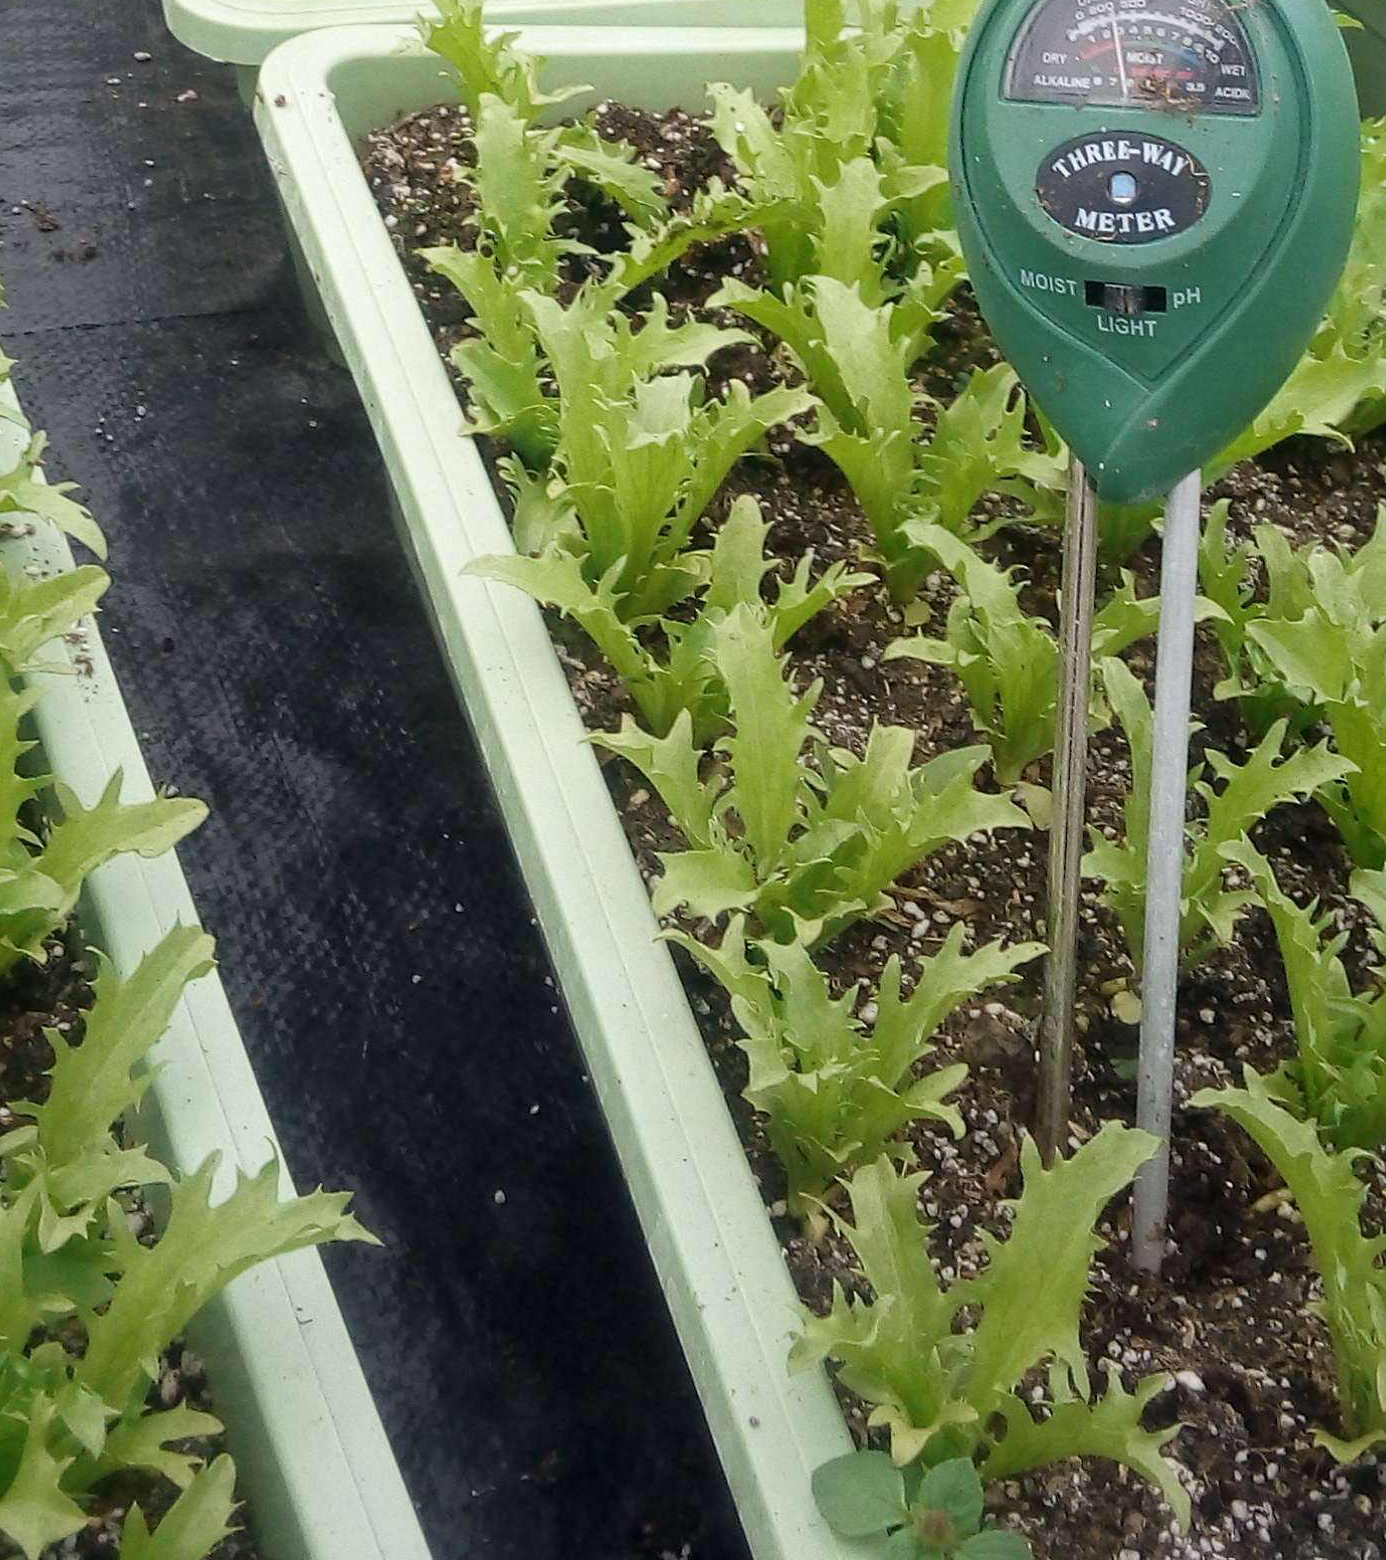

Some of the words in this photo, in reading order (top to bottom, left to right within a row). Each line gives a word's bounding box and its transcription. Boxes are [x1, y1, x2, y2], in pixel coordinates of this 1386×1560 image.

[1170, 31, 1181, 41] 7
[1214, 24, 1241, 50] 200
[1041, 51, 1068, 65] DRY
[1126, 51, 1164, 65] MOIST
[1220, 63, 1246, 77] WET
[1033, 74, 1092, 89] ALKALINE
[1051, 140, 1189, 178] THREE-WAY
[1074, 207, 1176, 233] METER
[1020, 269, 1077, 296] MOIST
[1173, 287, 1201, 309] pH
[1097, 315, 1157, 337] LIGHT
